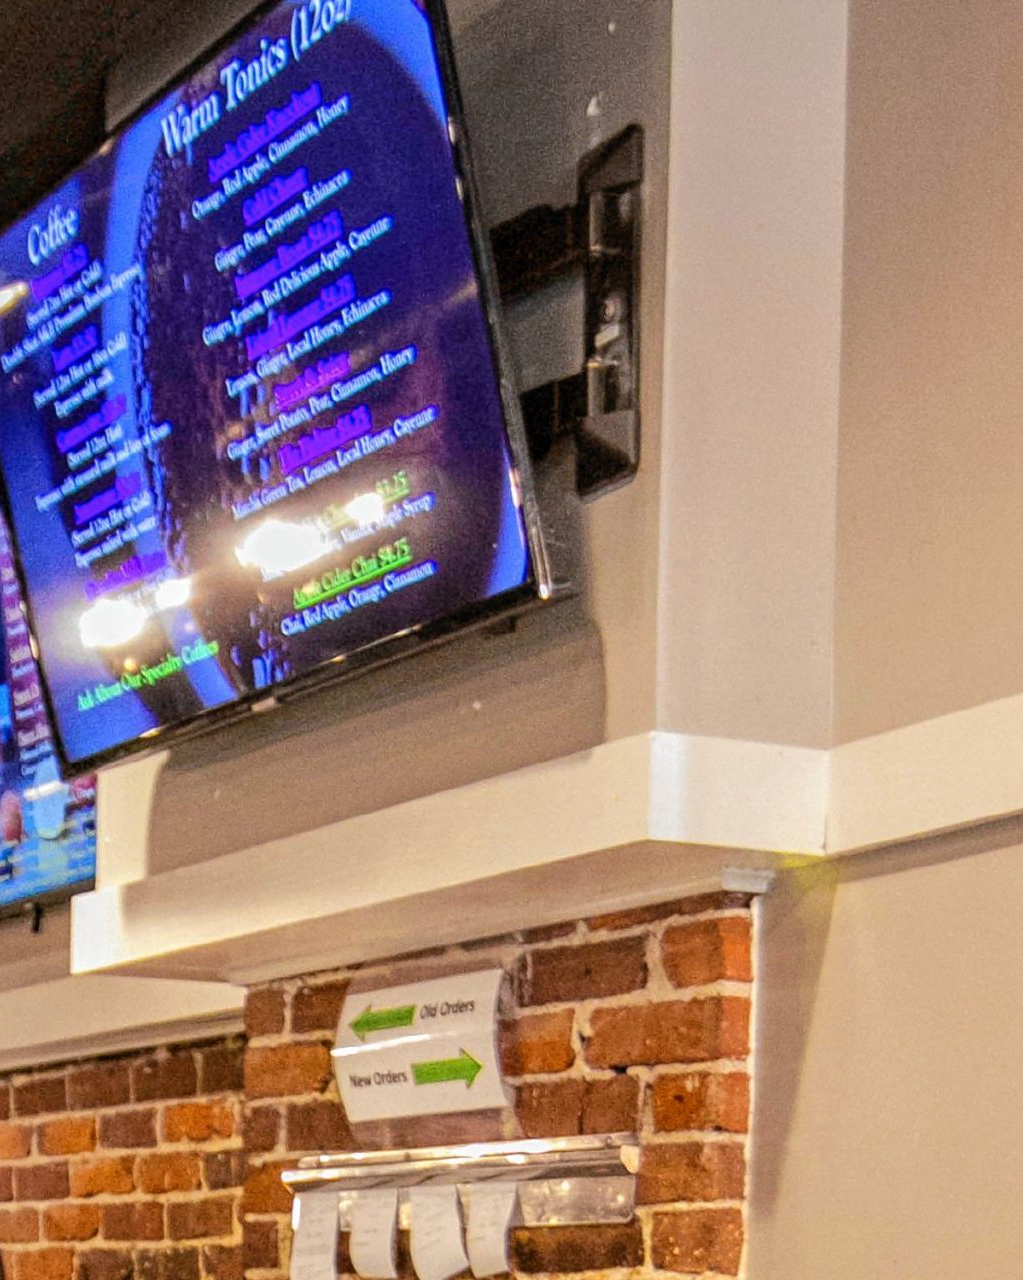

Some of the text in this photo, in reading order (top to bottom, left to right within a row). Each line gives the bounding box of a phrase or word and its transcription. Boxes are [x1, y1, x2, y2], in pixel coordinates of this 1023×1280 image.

[162, 93, 220, 157] Warm
[221, 38, 289, 111] Tonics
[317, 97, 348, 126] Honey
[28, 205, 78, 266] Coffee
[262, 282, 280, 307] Red
[286, 333, 310, 360] Local
[380, 346, 416, 374] Honey
[261, 485, 285, 504] Green
[336, 442, 359, 466] Local
[394, 408, 435, 436] Cayenne
[402, 494, 435, 518] Syrup
[320, 567, 351, 591] Cider
[351, 550, 378, 578] Chai
[303, 605, 321, 627] Red
[383, 562, 434, 593] Cinnamon
[420, 1000, 475, 1020] Old Orders
[349, 1071, 408, 1088] New Orders
